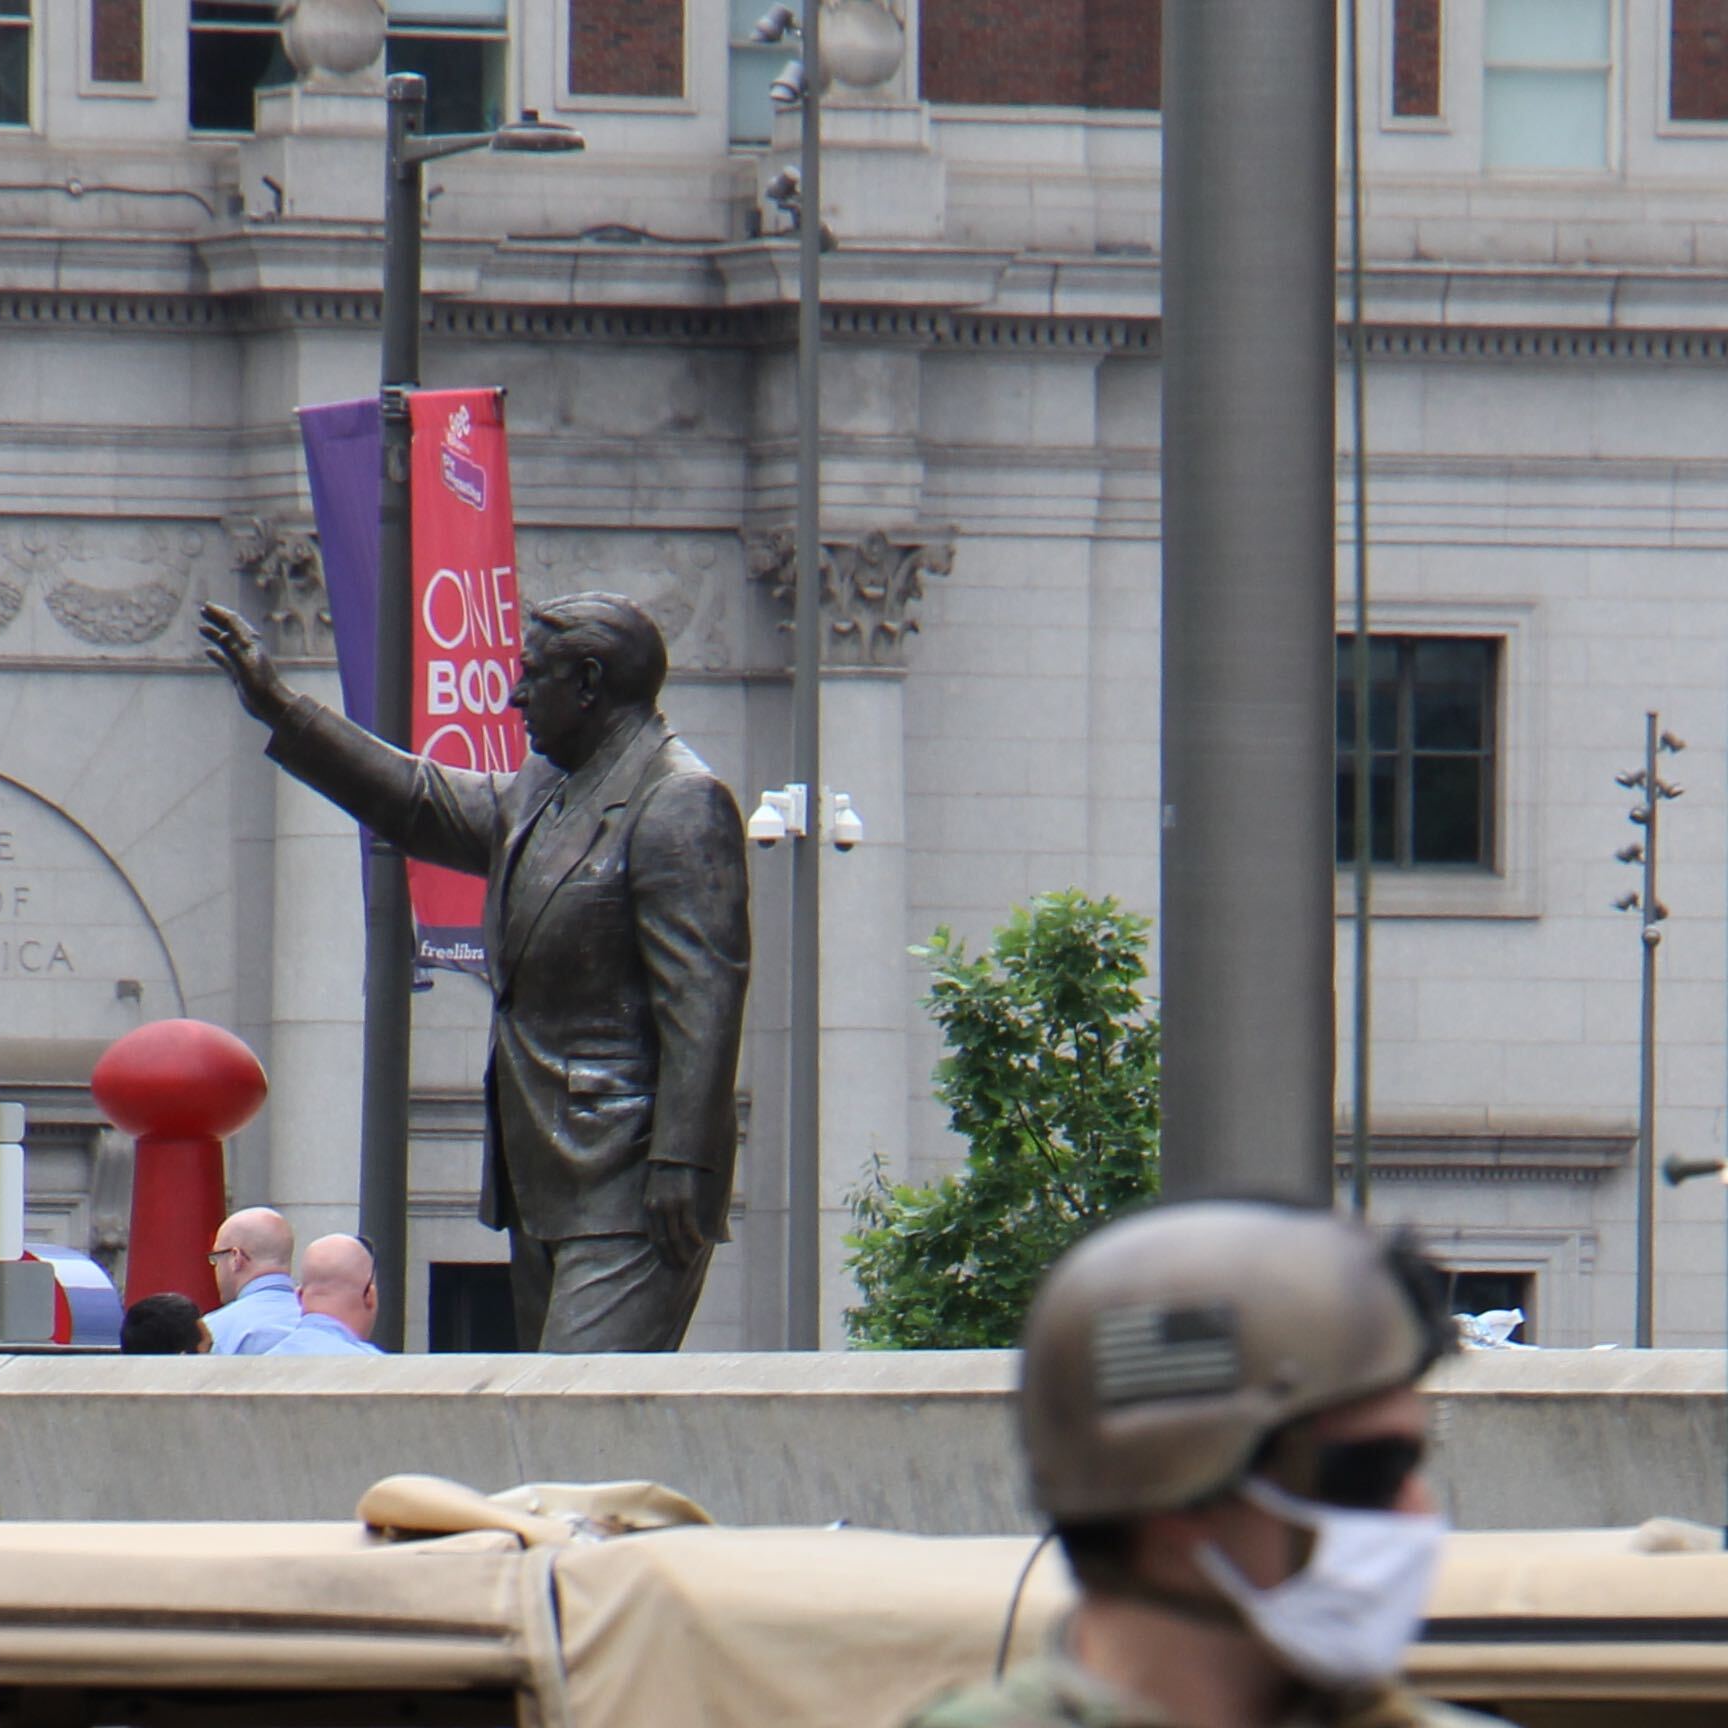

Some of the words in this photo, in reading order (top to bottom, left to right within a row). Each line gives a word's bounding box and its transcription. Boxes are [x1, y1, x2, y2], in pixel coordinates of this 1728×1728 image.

[423, 565, 515, 650] ONE
[427, 658, 516, 716] BOO
[422, 723, 519, 773] ON
[420, 940, 485, 960] freelibra
